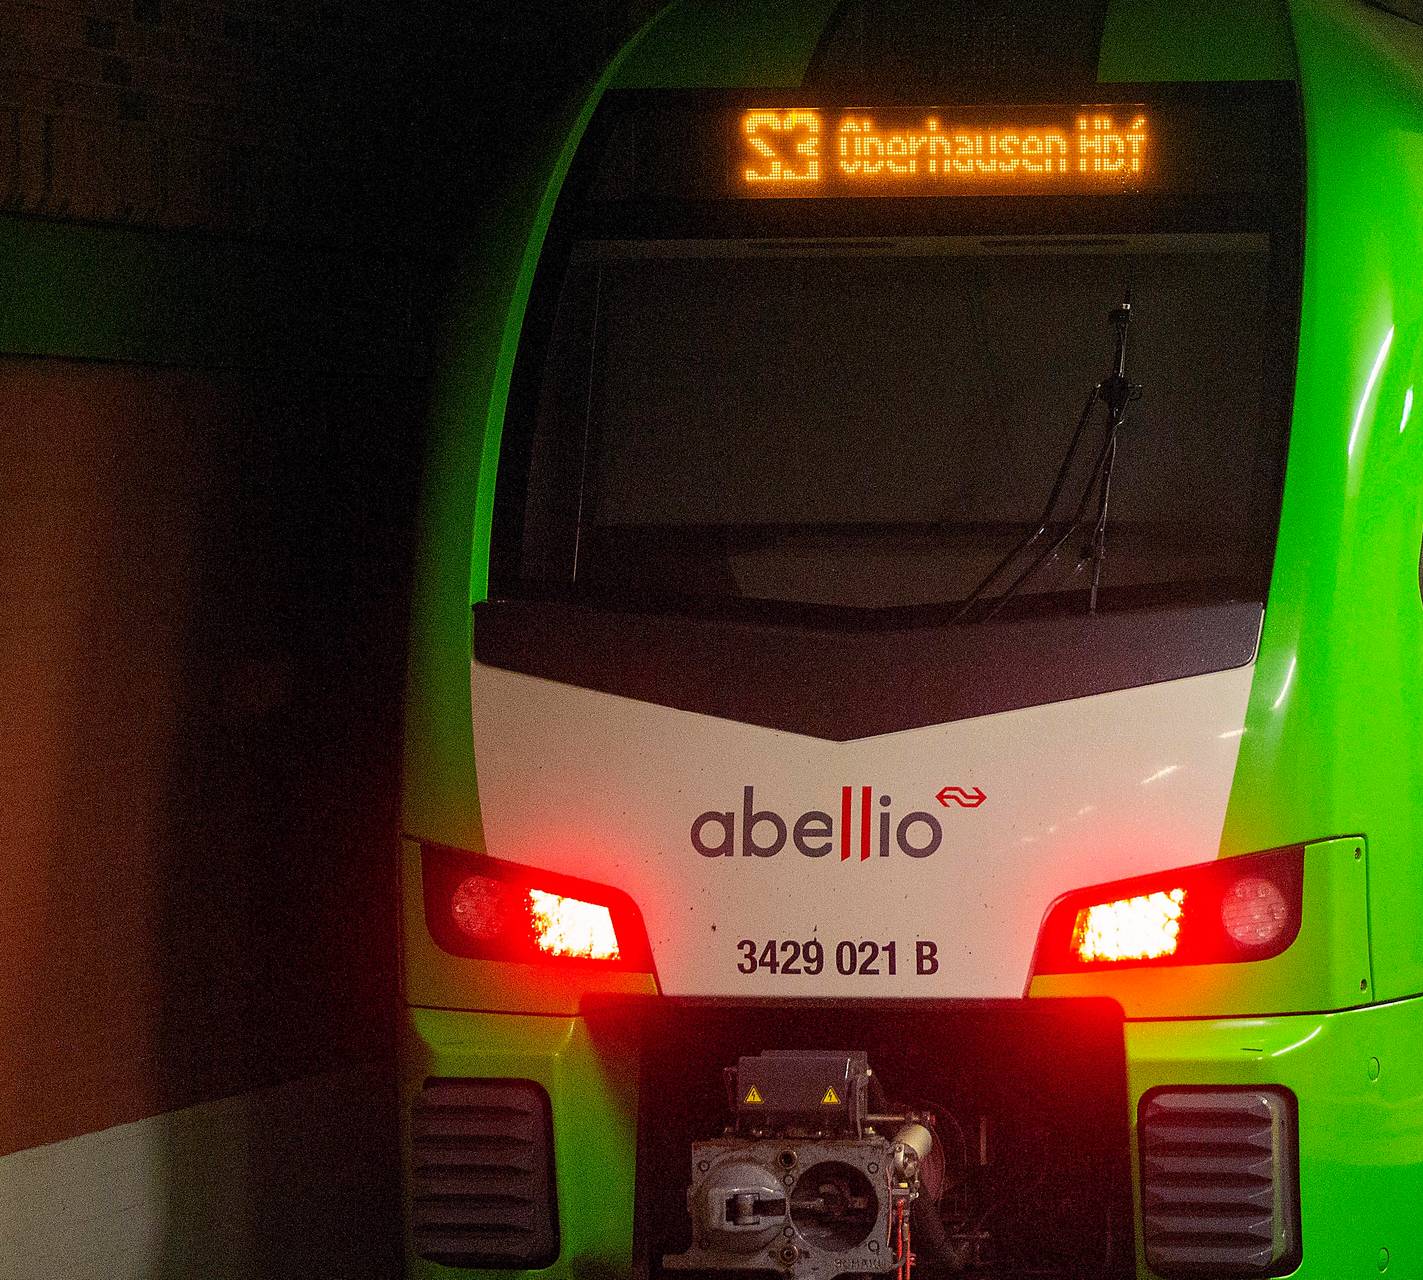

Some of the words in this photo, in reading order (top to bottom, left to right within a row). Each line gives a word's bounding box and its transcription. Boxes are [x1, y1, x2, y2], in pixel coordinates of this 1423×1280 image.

[745, 113, 819, 181] S3
[840, 116, 1067, 174] Oberhausen
[1079, 115, 1146, 173] Hbf
[690, 785, 943, 861] abellio
[736, 940, 824, 975] 3429
[836, 941, 897, 975] 021
[916, 941, 939, 975] B
